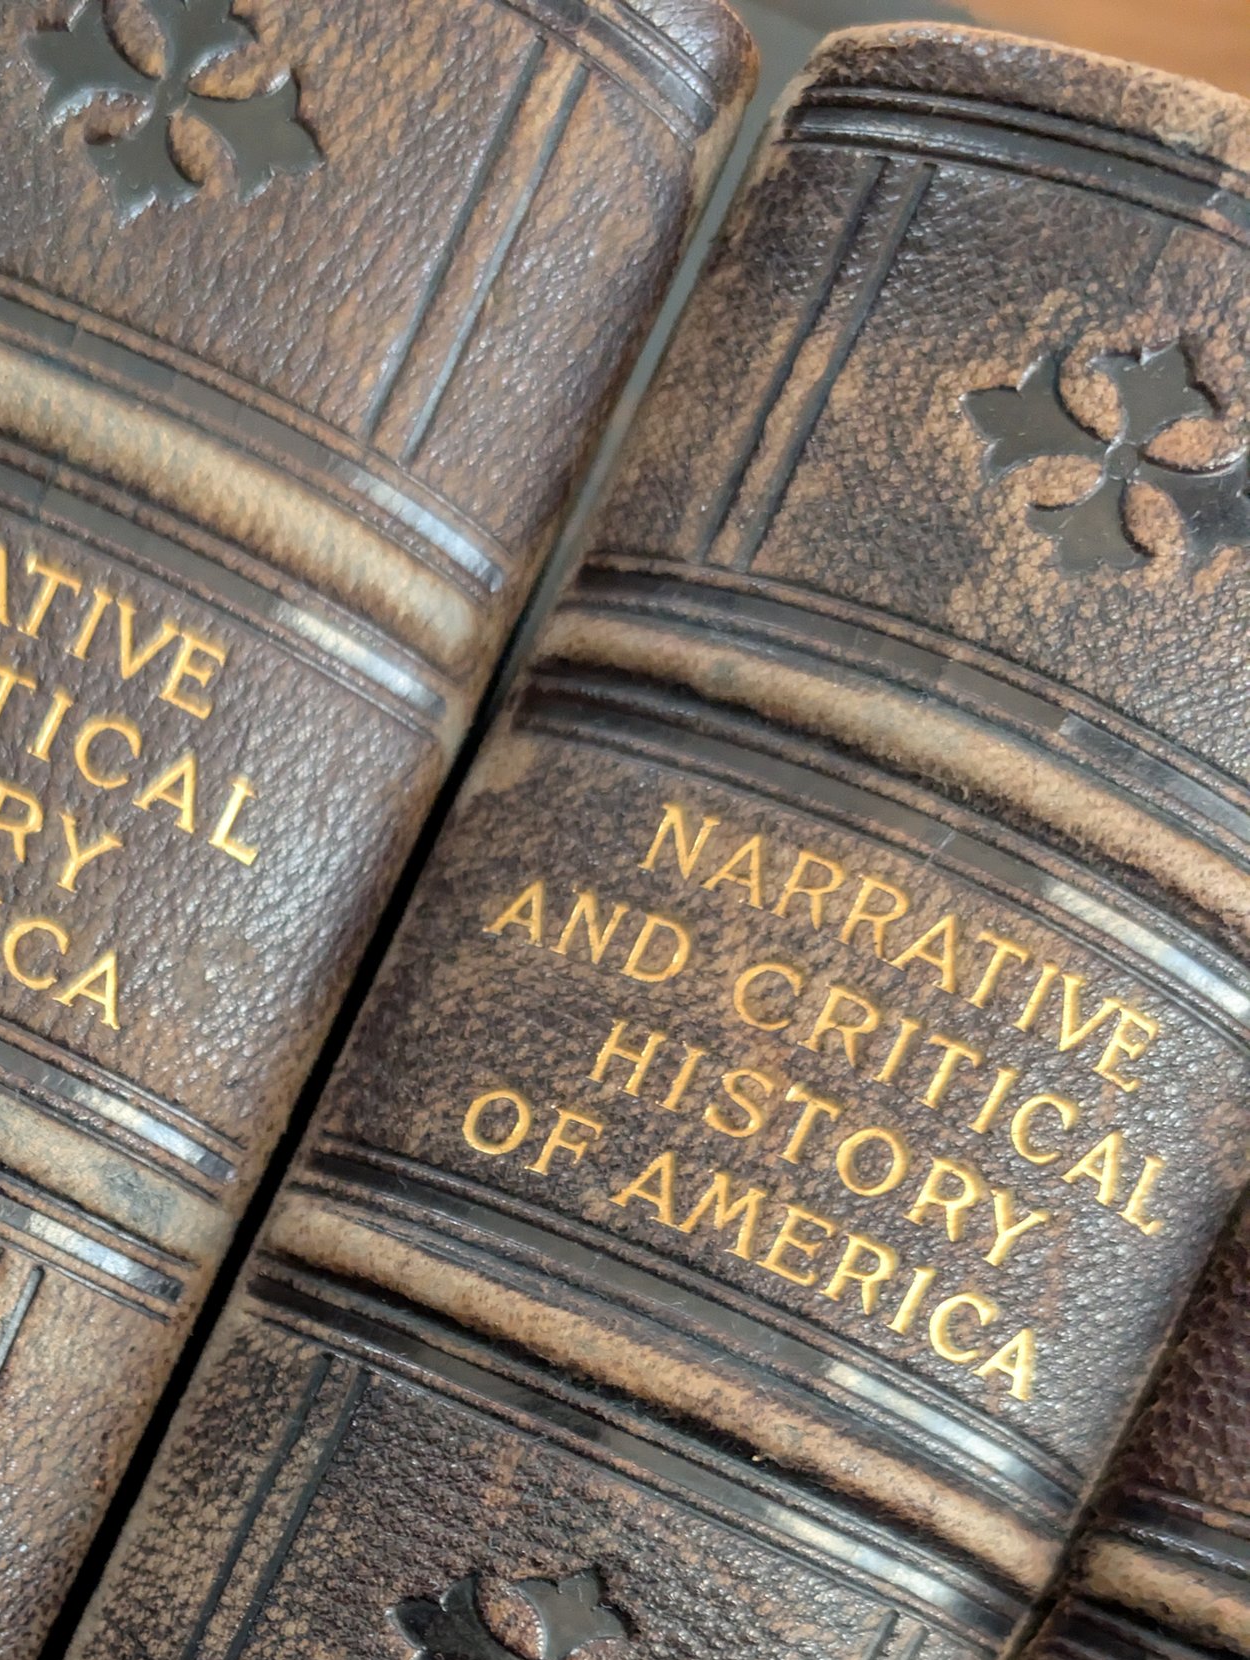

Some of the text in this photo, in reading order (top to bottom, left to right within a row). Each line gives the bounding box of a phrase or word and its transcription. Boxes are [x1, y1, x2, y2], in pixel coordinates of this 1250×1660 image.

[483, 880, 1170, 1235] AND CRITICAL
[637, 804, 1160, 1092] NARRATIVE
[462, 1089, 1037, 1402] OF AMERICA
[586, 1019, 1046, 1266] HISTORY
